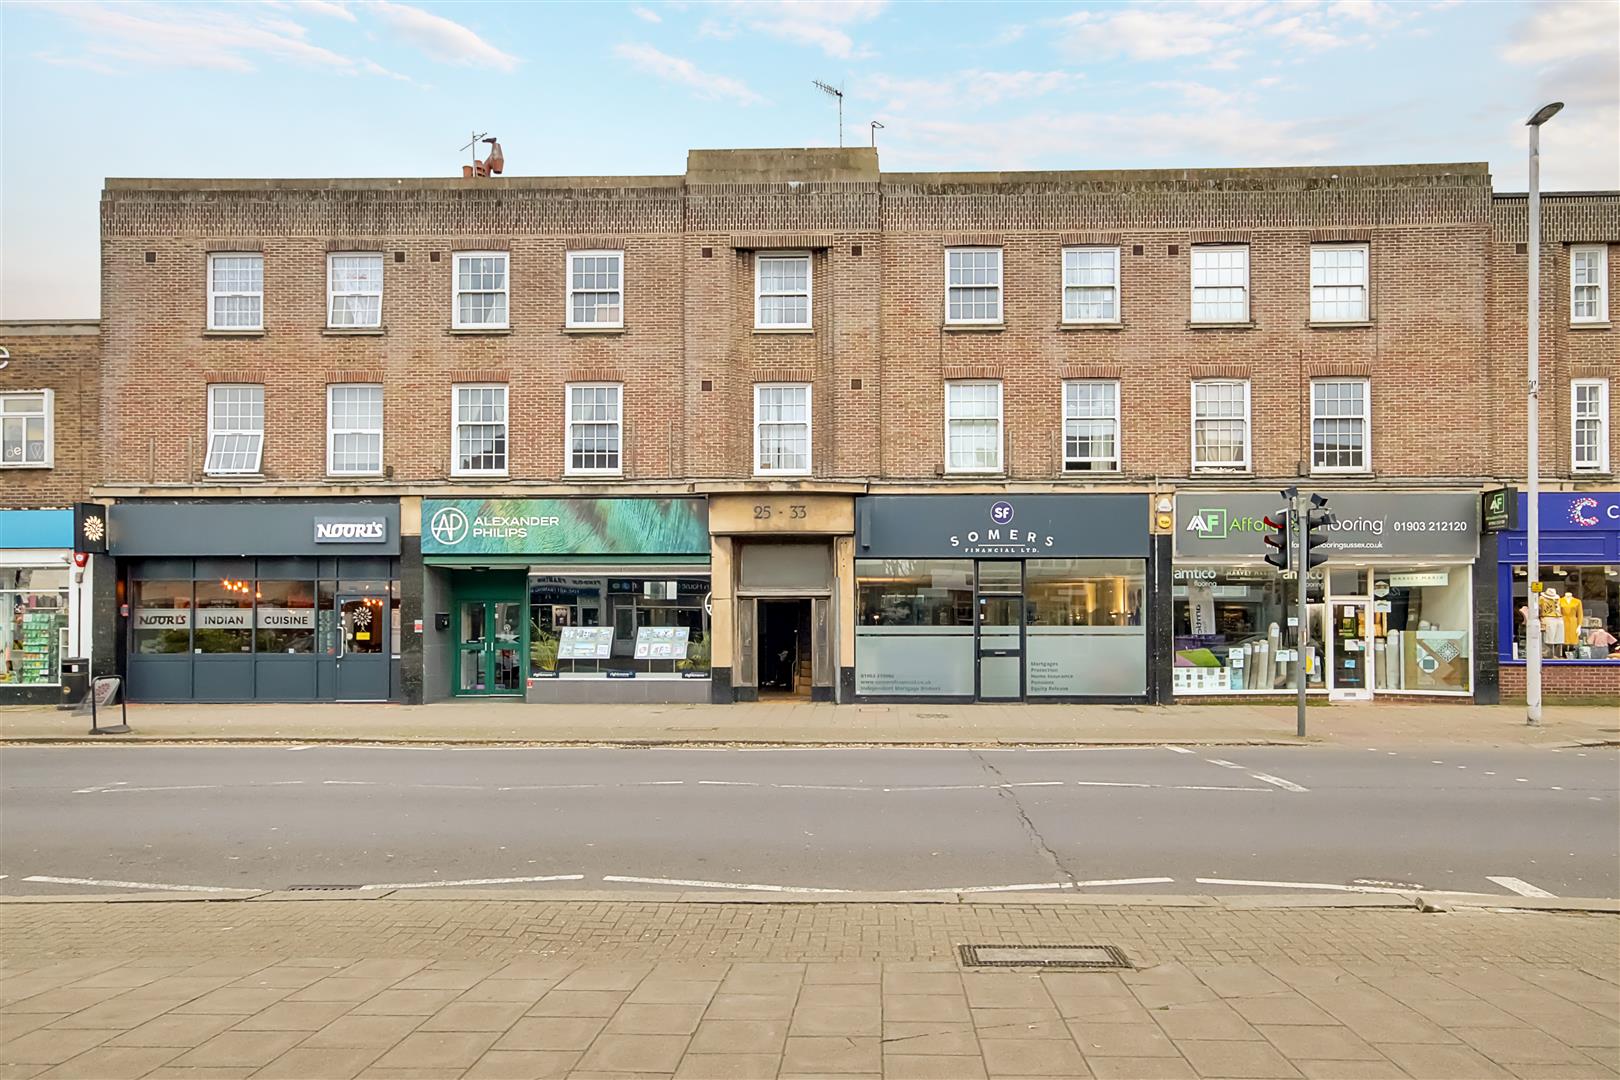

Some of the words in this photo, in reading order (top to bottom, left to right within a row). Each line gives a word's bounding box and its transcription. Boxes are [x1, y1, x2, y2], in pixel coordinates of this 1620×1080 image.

[753, 505, 771, 520] 25
[790, 505, 807, 519] 33
[994, 507, 1010, 519] SF
[473, 517, 560, 526] ALEXANDER
[1393, 521, 1426, 531] 01903
[1428, 521, 1467, 531] 212120
[473, 528, 528, 538] PHILIPS
[950, 529, 1054, 546] SOMERS
[1174, 568, 1217, 579] amtico
[204, 616, 244, 625] INDIAN
[264, 616, 308, 625] CUISINE
